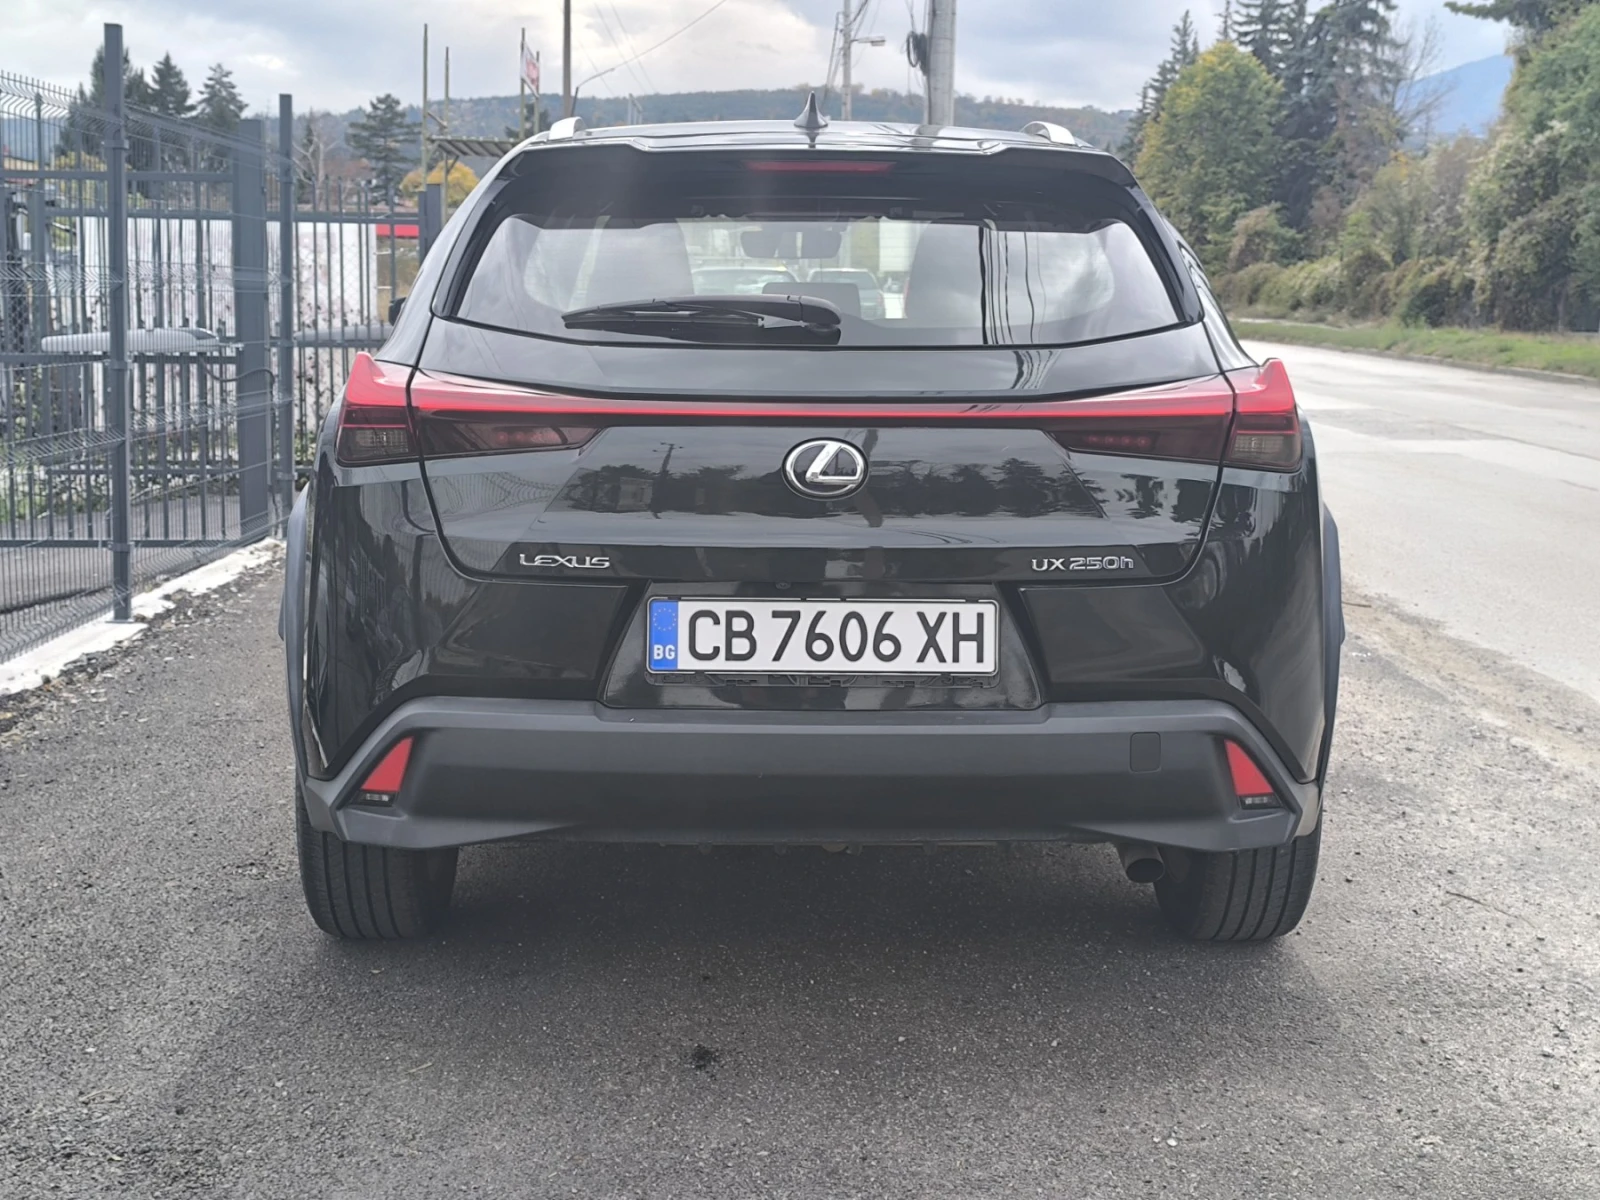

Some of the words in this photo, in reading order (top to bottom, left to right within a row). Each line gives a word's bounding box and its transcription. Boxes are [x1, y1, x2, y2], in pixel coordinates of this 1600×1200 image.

[519, 553, 611, 569] LEXUS
[1031, 558, 1067, 571] UX
[1069, 556, 1134, 570] 250h
[688, 610, 757, 662] CB
[771, 610, 902, 662] 7606
[916, 611, 985, 663] XH
[653, 644, 676, 660] BG
